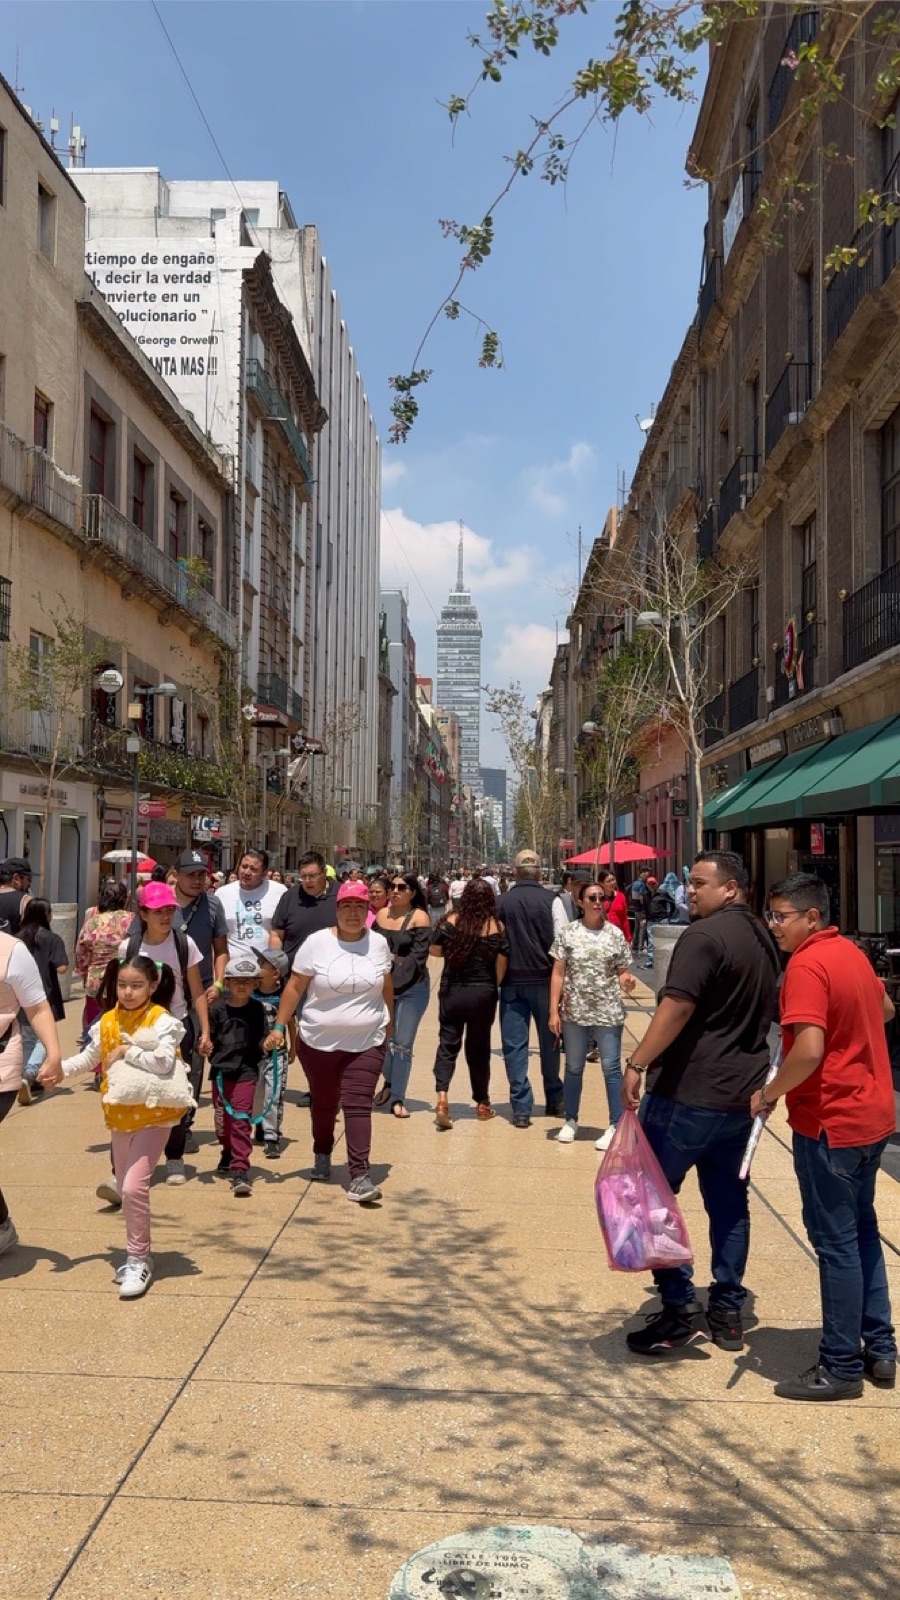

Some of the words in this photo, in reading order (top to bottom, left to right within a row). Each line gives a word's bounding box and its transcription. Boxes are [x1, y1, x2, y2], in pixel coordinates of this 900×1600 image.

[85, 252, 136, 267] tiempo
[141, 252, 158, 264] de
[163, 252, 215, 267] engaño
[105, 271, 142, 284] decir
[146, 271, 159, 284] la
[163, 271, 212, 284] verdad
[161, 292, 178, 303] en
[183, 292, 200, 303] un
[181, 356, 204, 376] MAS
